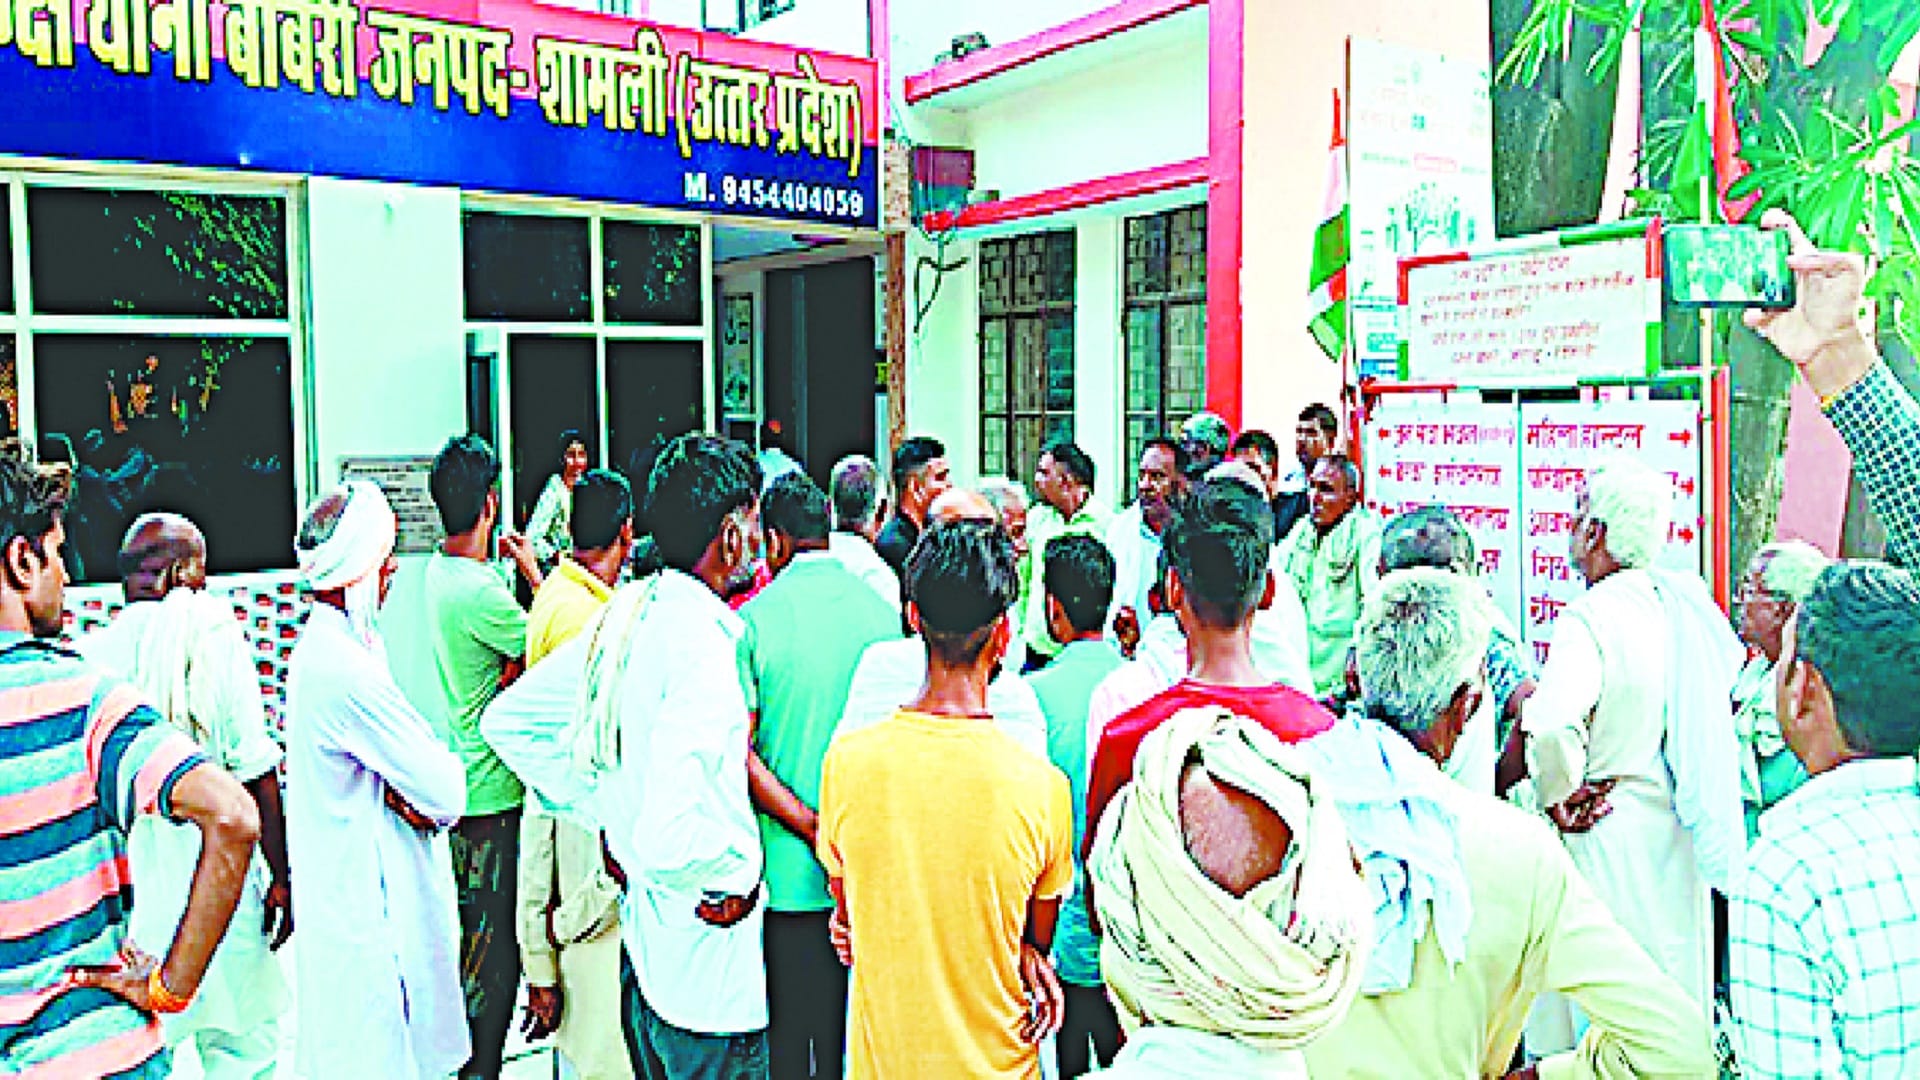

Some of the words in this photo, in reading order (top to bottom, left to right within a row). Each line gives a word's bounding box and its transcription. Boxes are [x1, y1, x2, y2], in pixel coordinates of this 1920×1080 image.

[536, 28, 668, 136] शामली
[776, 53, 862, 178] प्रदेश)
[684, 172, 716, 202] M.
